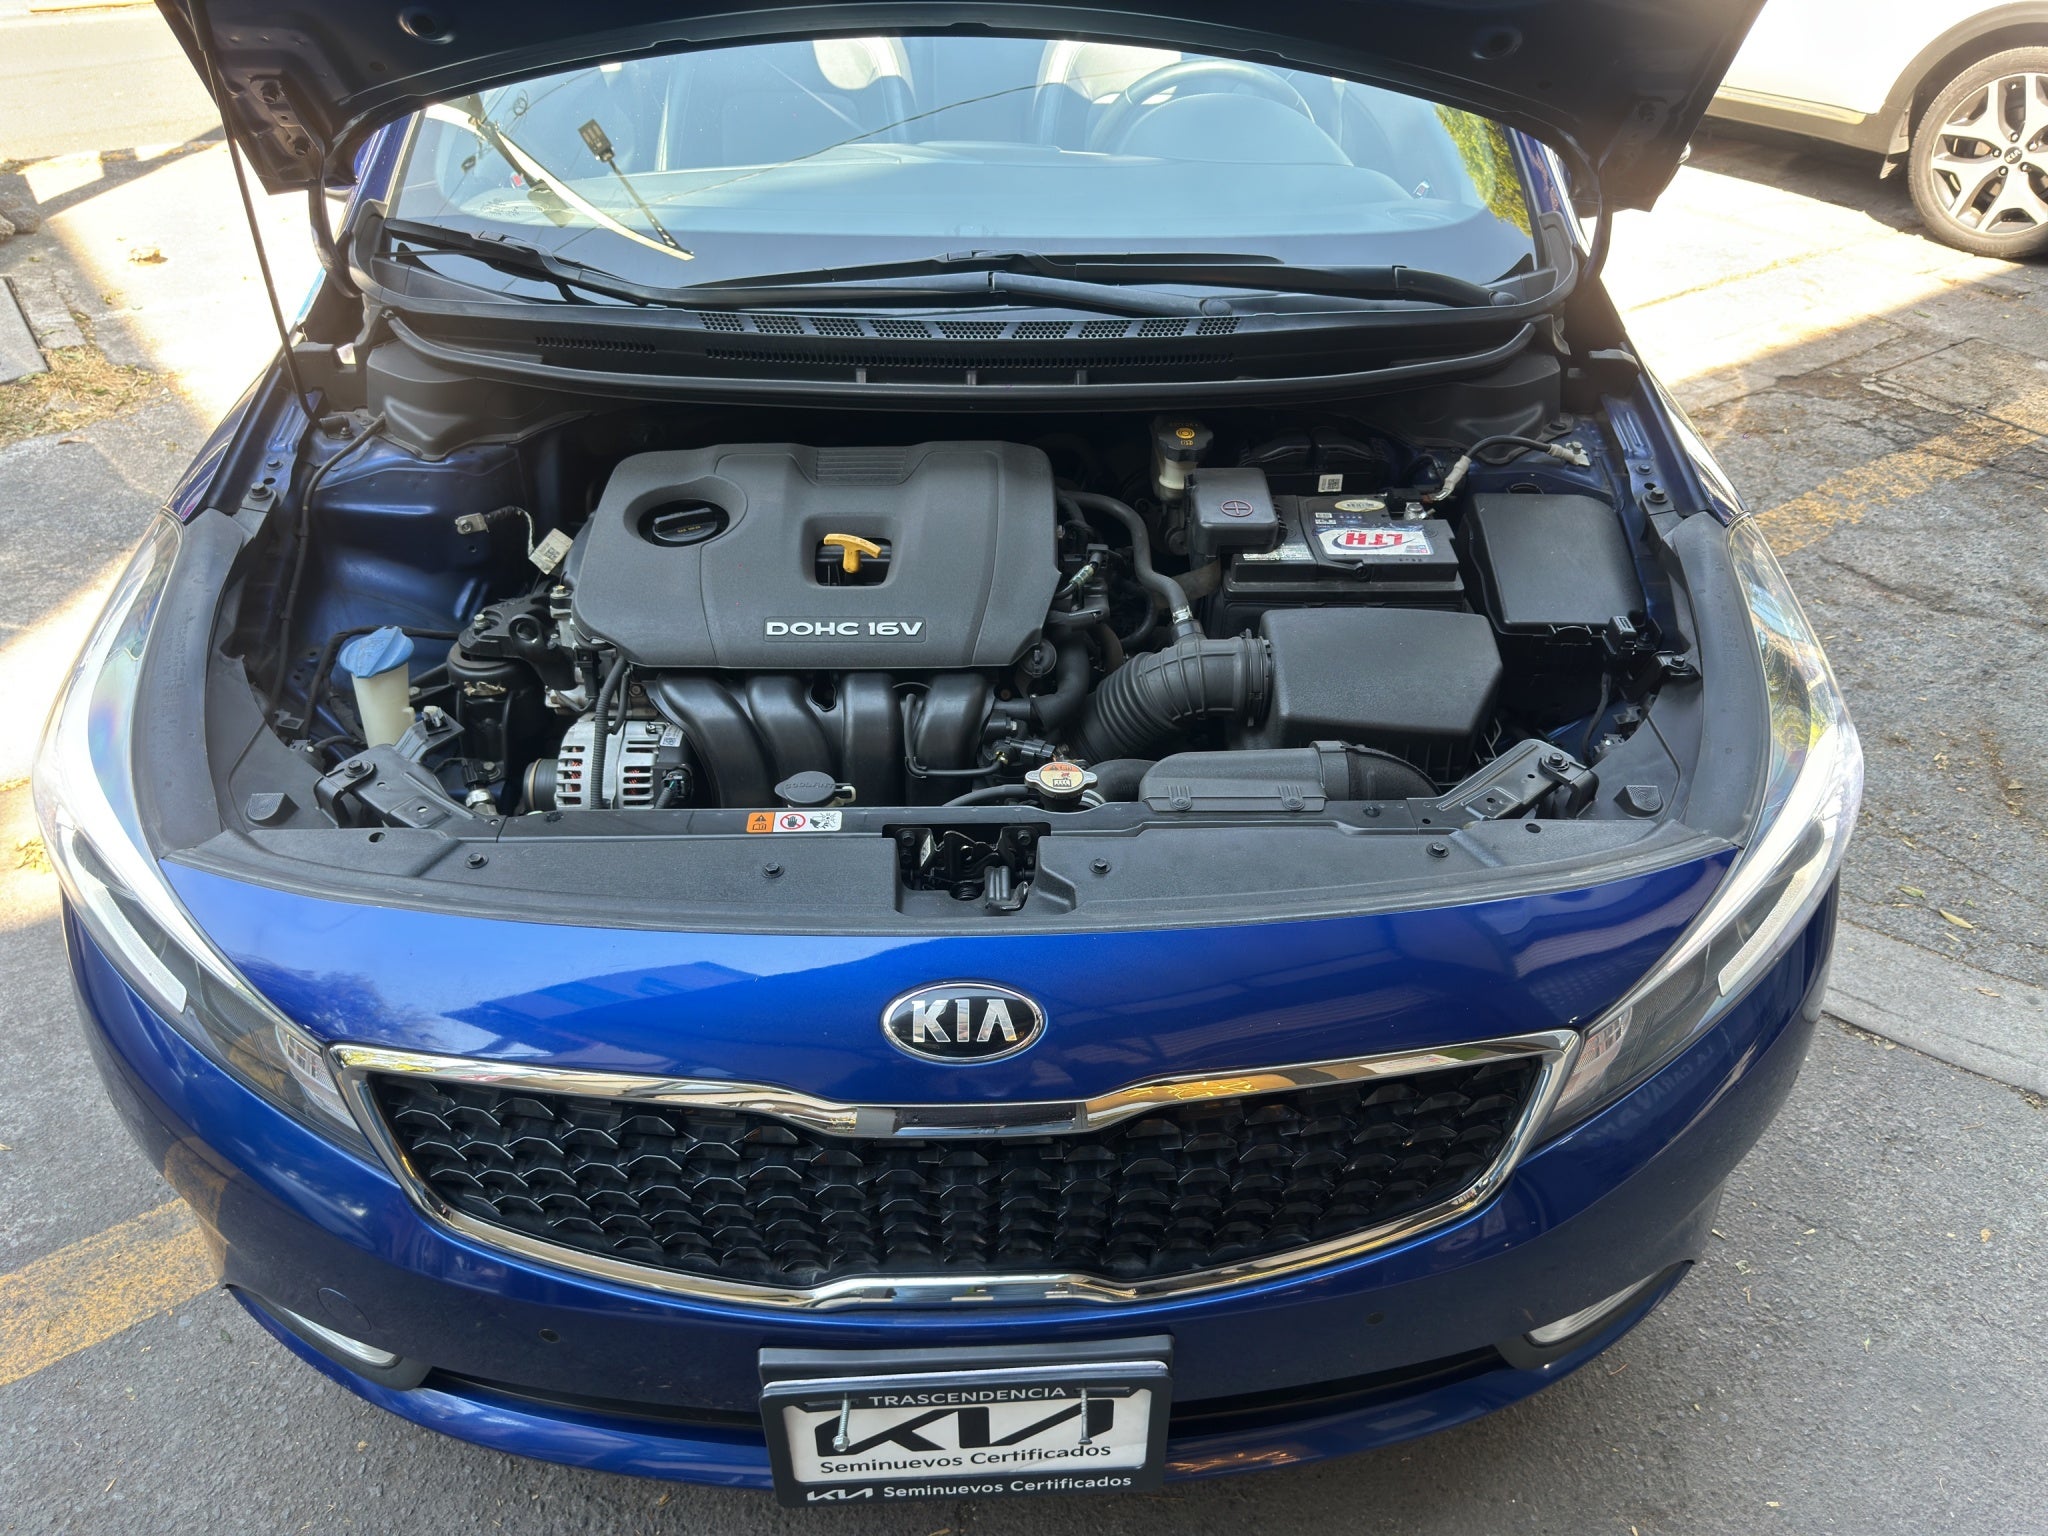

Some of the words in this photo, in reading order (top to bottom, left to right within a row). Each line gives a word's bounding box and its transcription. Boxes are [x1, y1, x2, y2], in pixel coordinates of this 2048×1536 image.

[766, 621, 859, 636] DOHC
[868, 621, 923, 636] 16V
[912, 999, 1018, 1042] KIA
[868, 1387, 1067, 1407] TRASCENDENCIA
[820, 1454, 963, 1475] Seminuevos
[970, 1444, 1112, 1465] Certificados
[883, 1482, 1004, 1498] Seminuevos
[1010, 1475, 1132, 1492] Certificados
